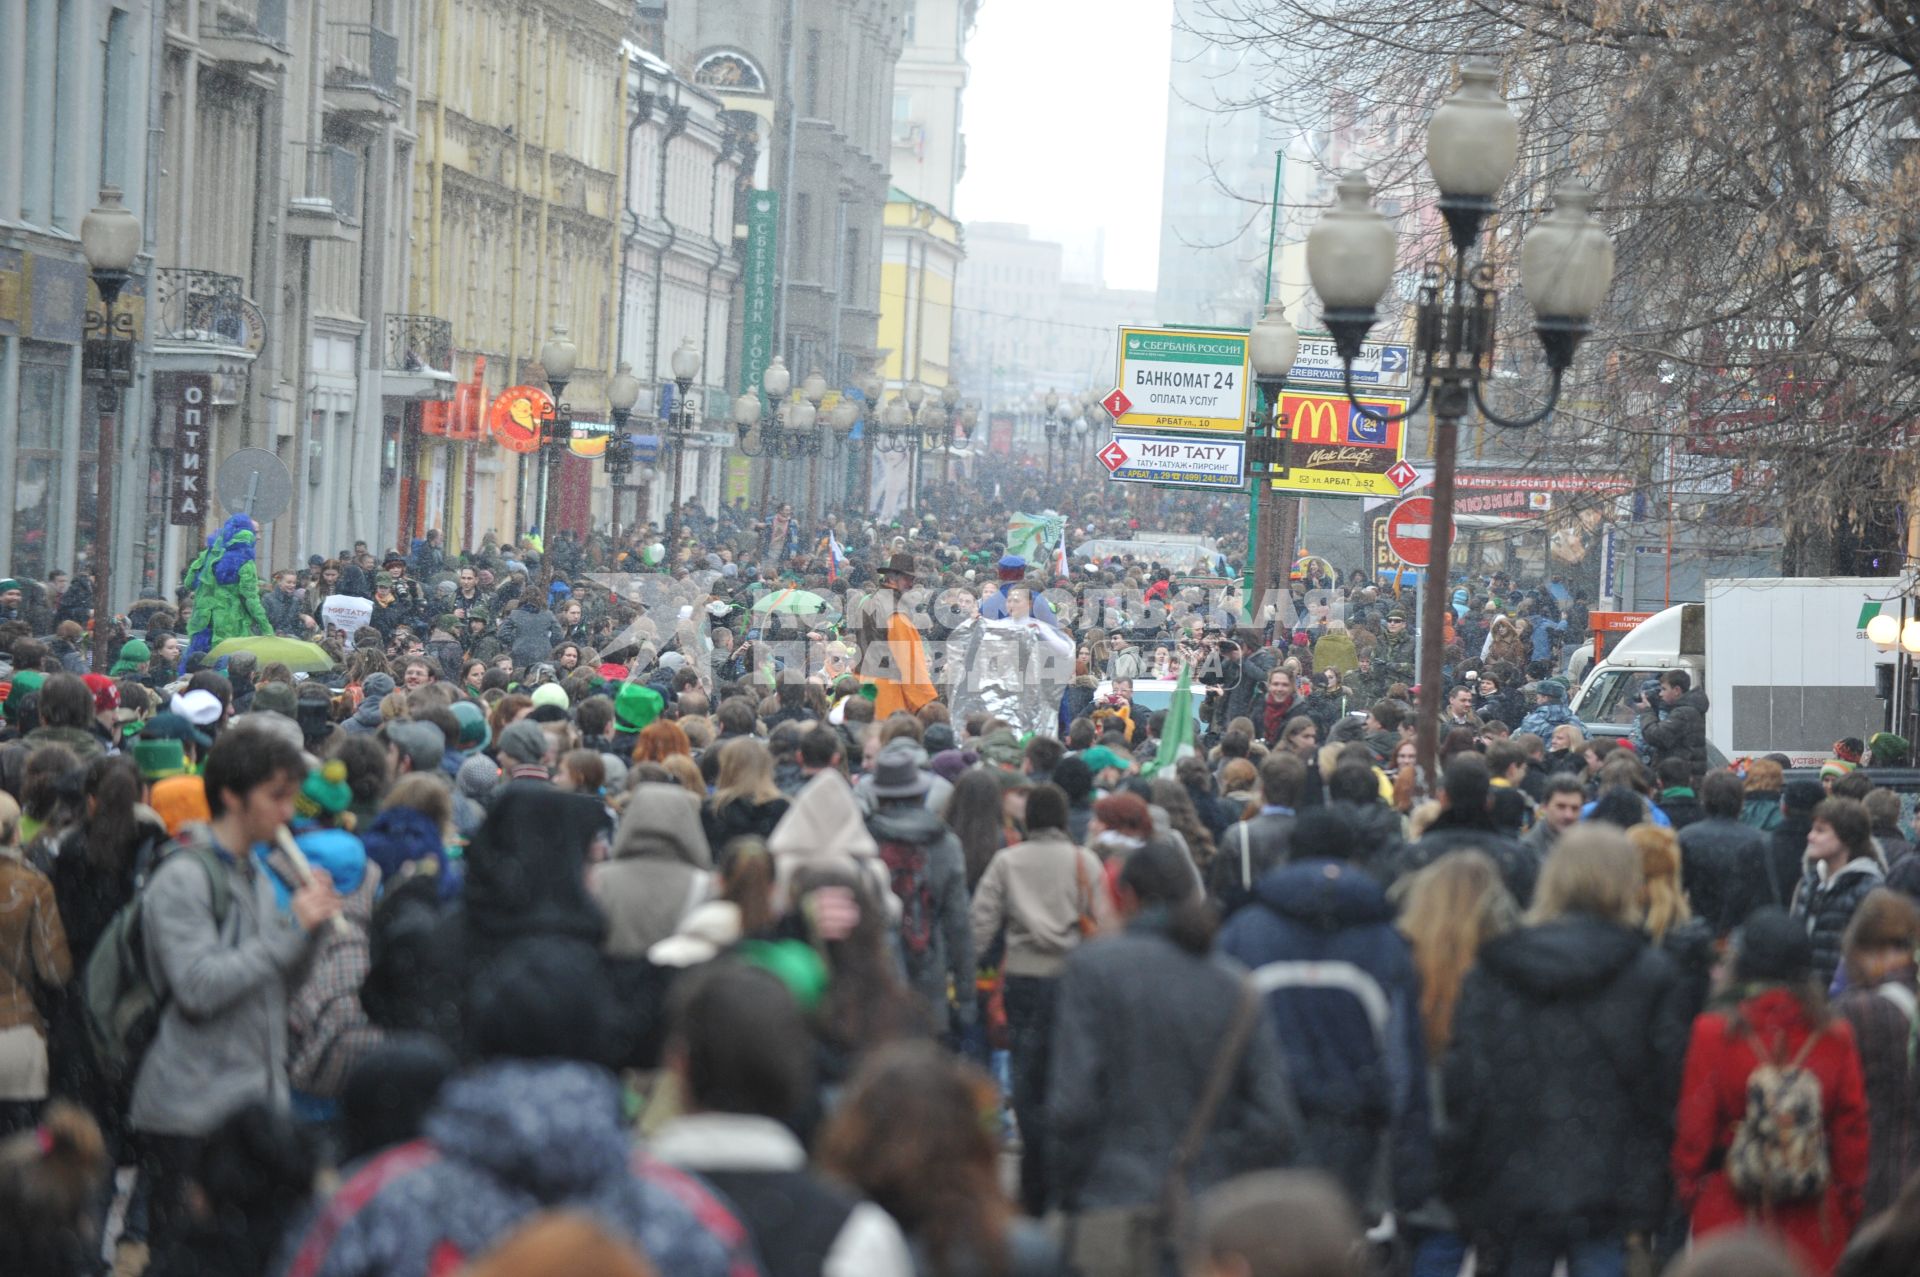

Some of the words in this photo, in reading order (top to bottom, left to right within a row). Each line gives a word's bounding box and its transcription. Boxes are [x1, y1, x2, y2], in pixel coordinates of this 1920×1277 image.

[754, 224, 770, 322] СБЕРБАНК
[1143, 340, 1196, 353] СБЕРБАНК
[1198, 344, 1241, 355] РОССИИ
[1136, 370, 1210, 388] БАНКОМАТ
[1213, 371, 1234, 390] 24
[1149, 393, 1187, 405] ОПЛАТА
[1190, 395, 1218, 407] УСЛУГ
[1156, 417, 1182, 425] АРБАТ
[1200, 419, 1210, 427] 10
[1363, 417, 1377, 428] 24
[181, 386, 203, 514] ОПТИКА
[1141, 443, 1180, 458] МИР
[1184, 446, 1227, 461] ТАТУ
[1137, 460, 1154, 468] ТАТУ
[1159, 461, 1188, 470] ТАТУАЖ
[1192, 463, 1229, 472] ПИРСИНГ
[1454, 491, 1525, 513] МЮЗИКЛ
